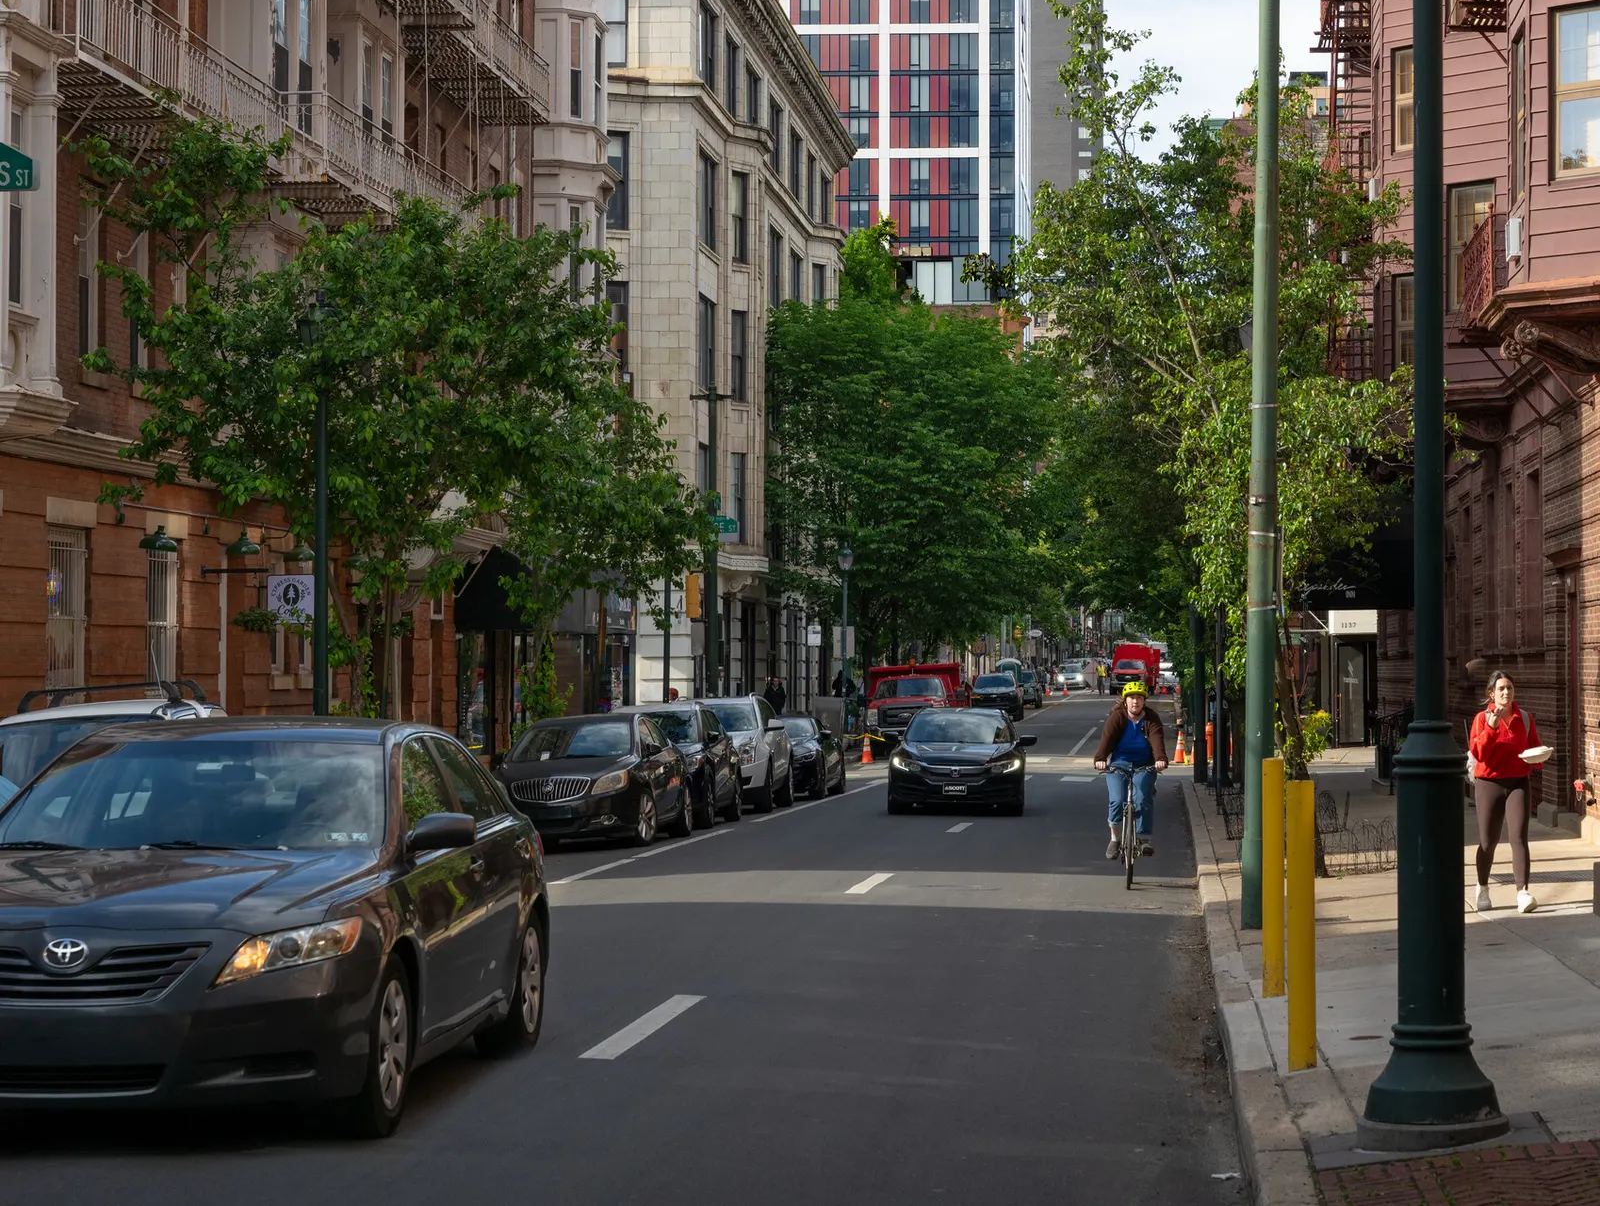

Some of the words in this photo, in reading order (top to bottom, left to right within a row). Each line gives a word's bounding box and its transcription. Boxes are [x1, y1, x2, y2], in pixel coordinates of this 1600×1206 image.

[15, 169, 29, 186] ST
[271, 577, 290, 597] CYPRESS
[292, 577, 311, 596] GARDEN
[277, 604, 306, 617] Coee
